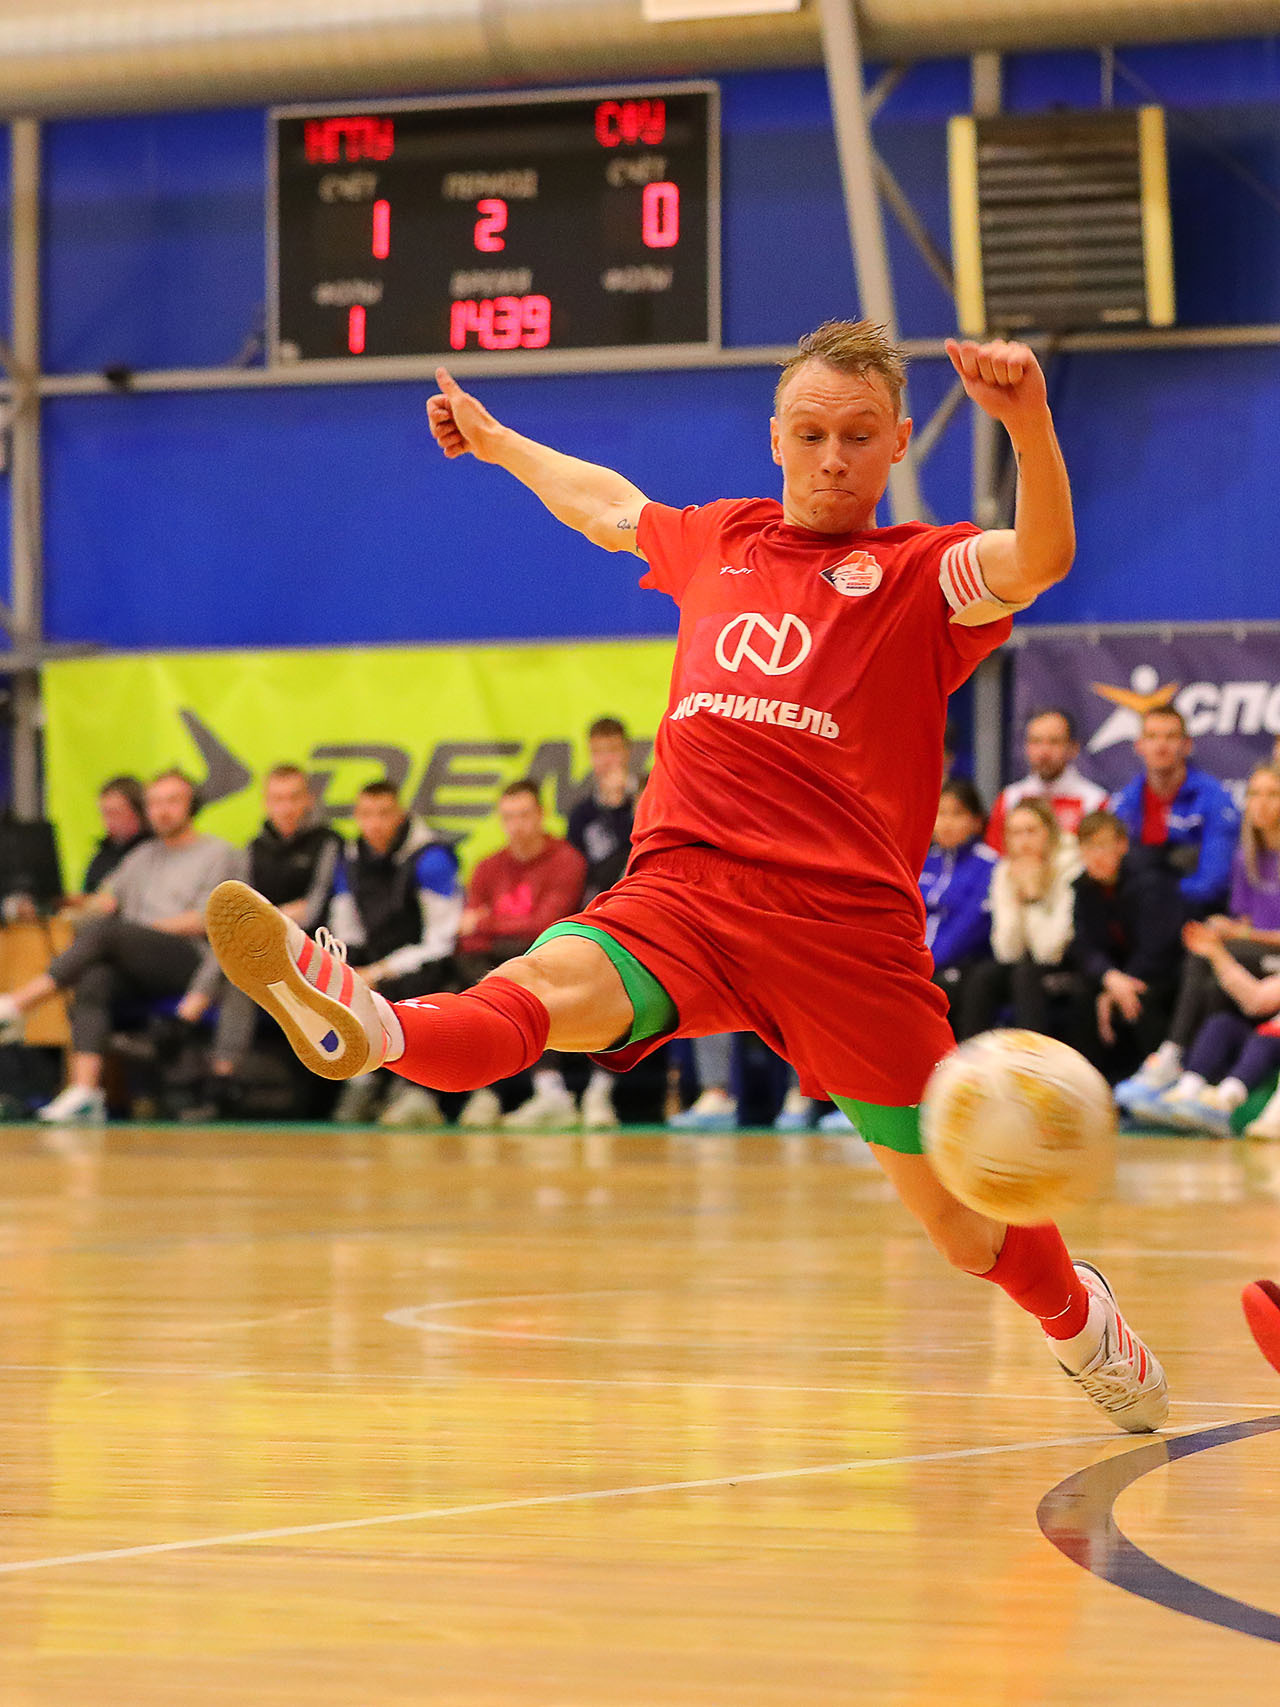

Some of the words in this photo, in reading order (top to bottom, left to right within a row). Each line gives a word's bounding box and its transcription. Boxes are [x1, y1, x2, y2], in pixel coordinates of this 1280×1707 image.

[372, 199, 390, 259] 1
[474, 198, 507, 252] 2
[642, 181, 679, 248] 0
[349, 305, 366, 354] 1
